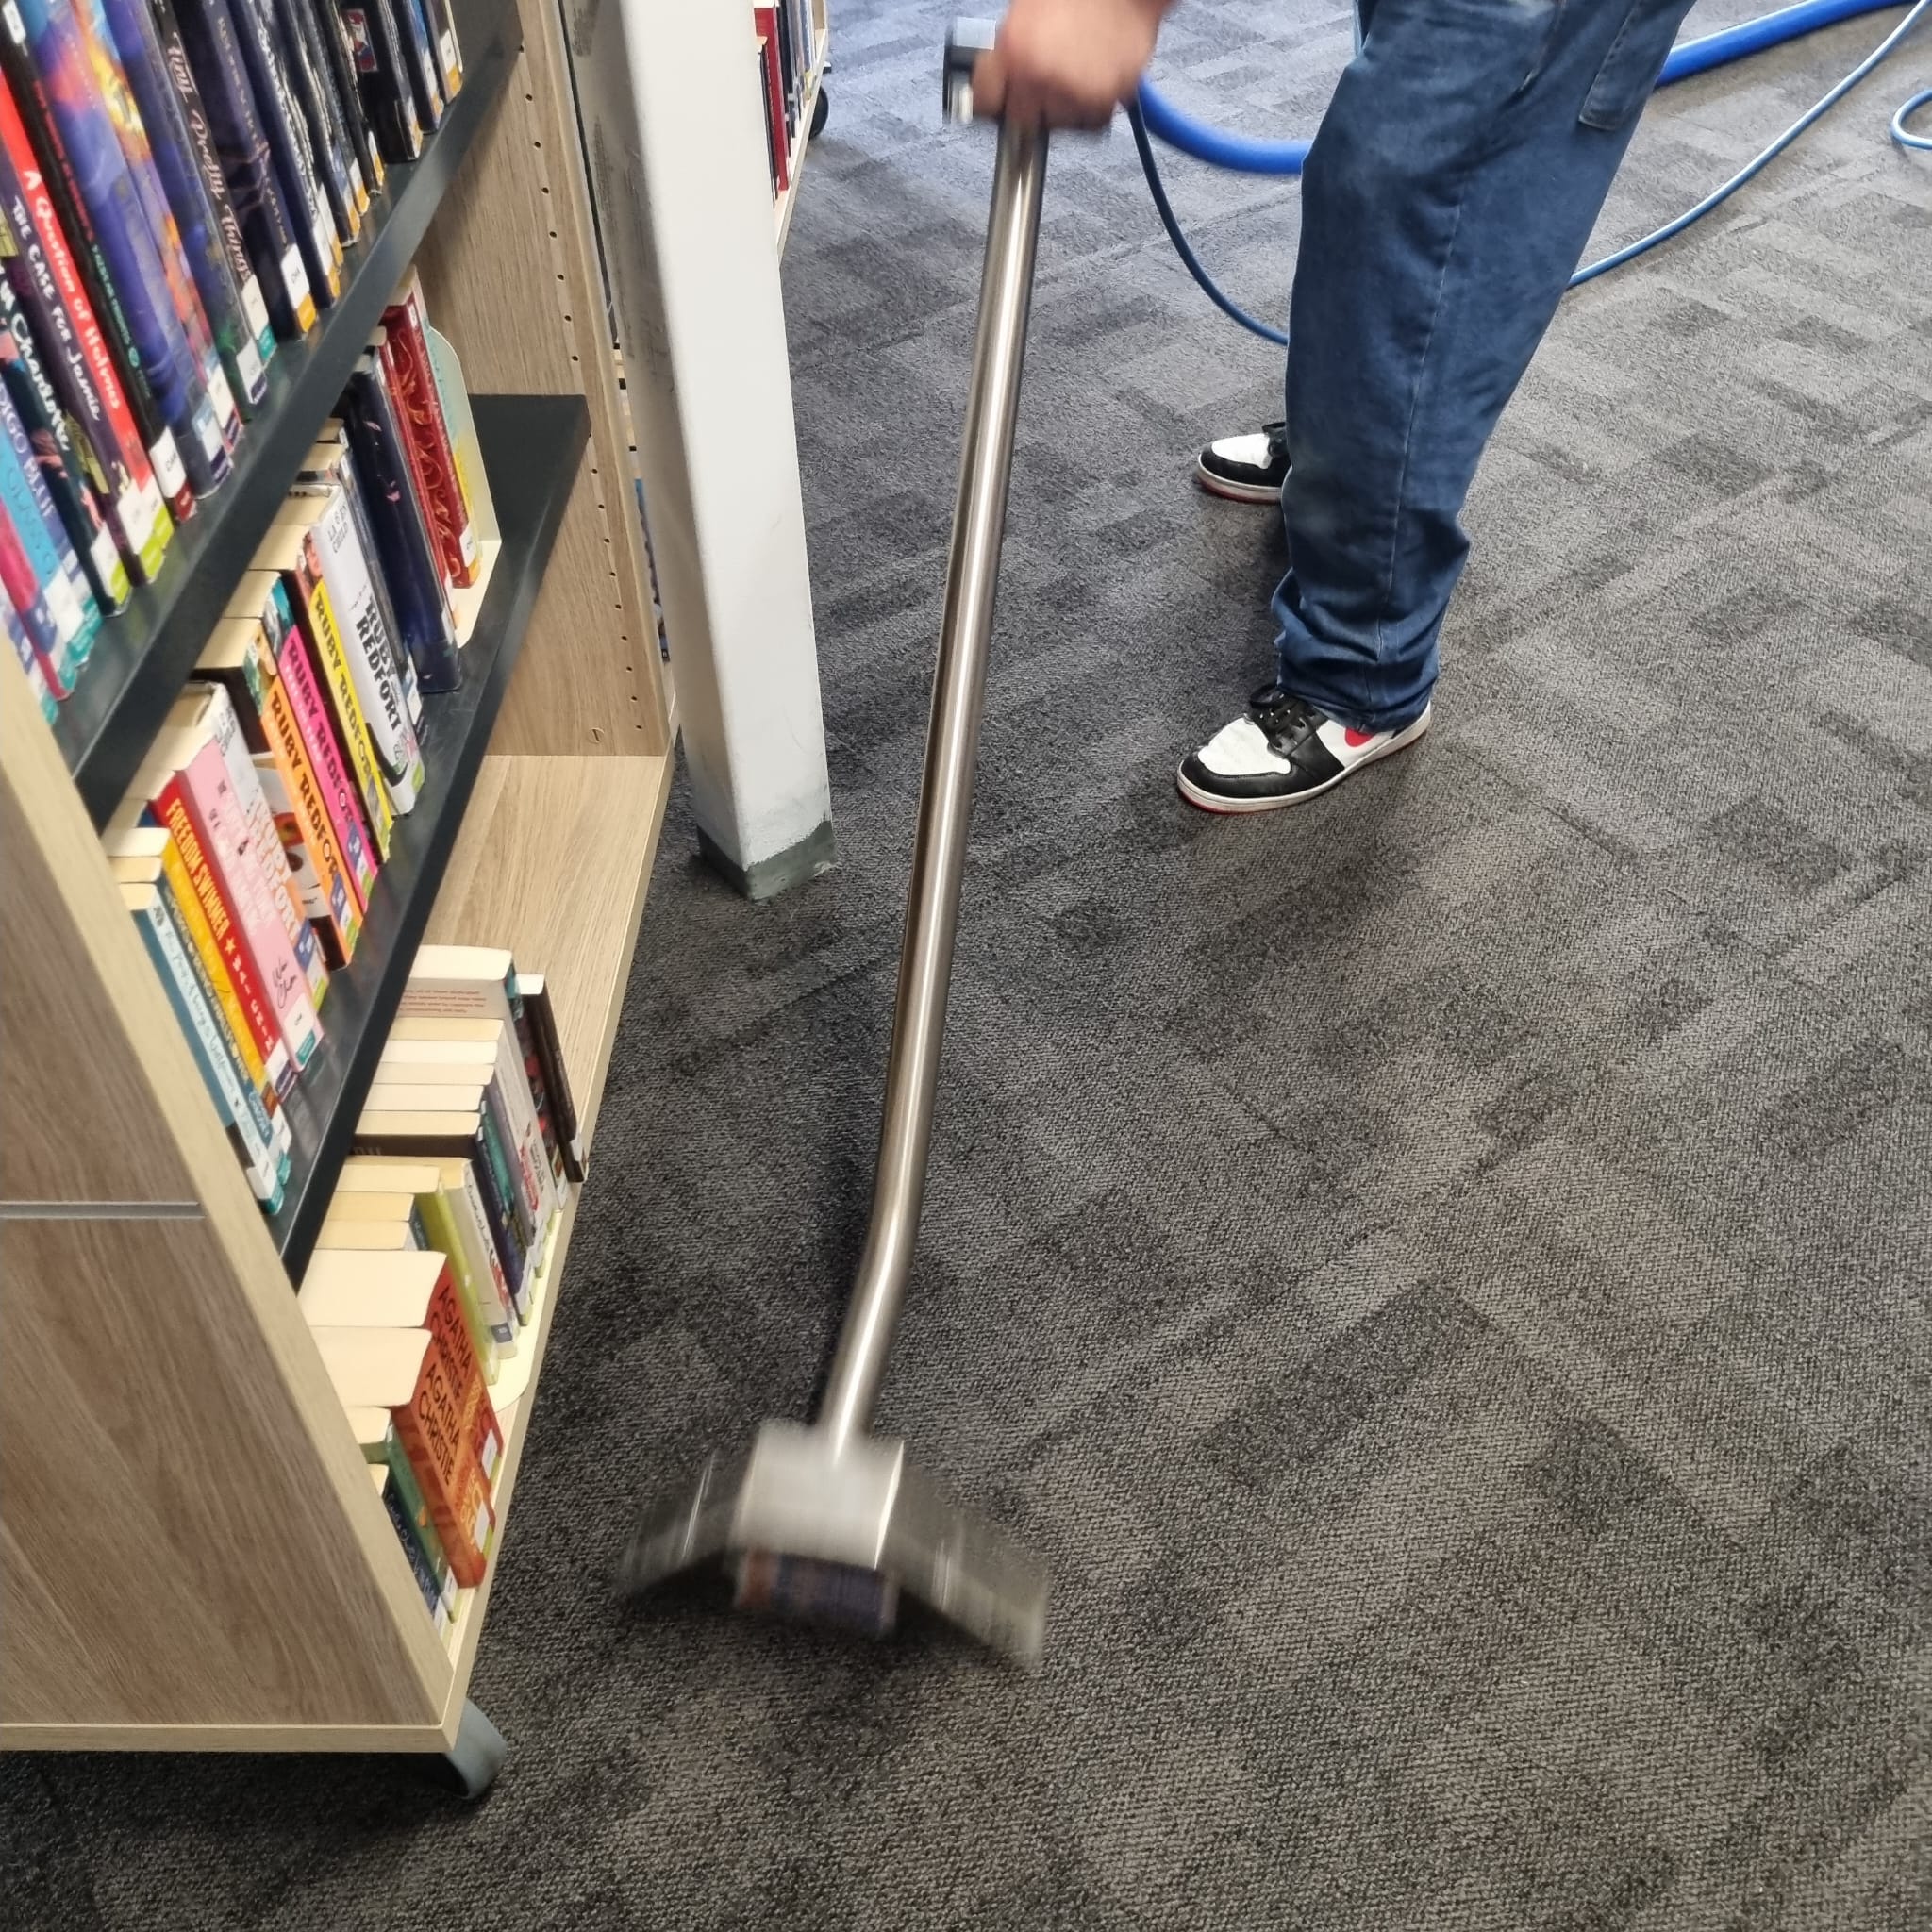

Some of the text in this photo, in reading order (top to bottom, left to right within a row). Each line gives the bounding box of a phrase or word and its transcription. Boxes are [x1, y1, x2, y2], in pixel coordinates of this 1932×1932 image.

[168, 32, 200, 103] Tiny
[190, 109, 225, 201] Pretty
[12, 195, 101, 421] THE CASE FOR Jamie
[25, 171, 42, 191] A
[36, 196, 75, 292] Question
[74, 298, 91, 321] of
[85, 327, 120, 410] Holmes
[11, 313, 70, 451] Charlotte
[315, 591, 372, 783] RUBY REDFOR
[356, 616, 402, 730] REDFORT
[366, 595, 396, 679] RUBY
[272, 690, 303, 772] RUBY
[300, 773, 338, 875] REDFOR
[287, 639, 318, 716] RUBY
[316, 721, 355, 826] REDFOR
[166, 799, 205, 865] FREEDOM
[193, 861, 230, 940] SWIMMER
[431, 1286, 471, 1401] AGATHA CHRISTIE
[418, 1363, 460, 1487] AGATHA CHRISTIE
